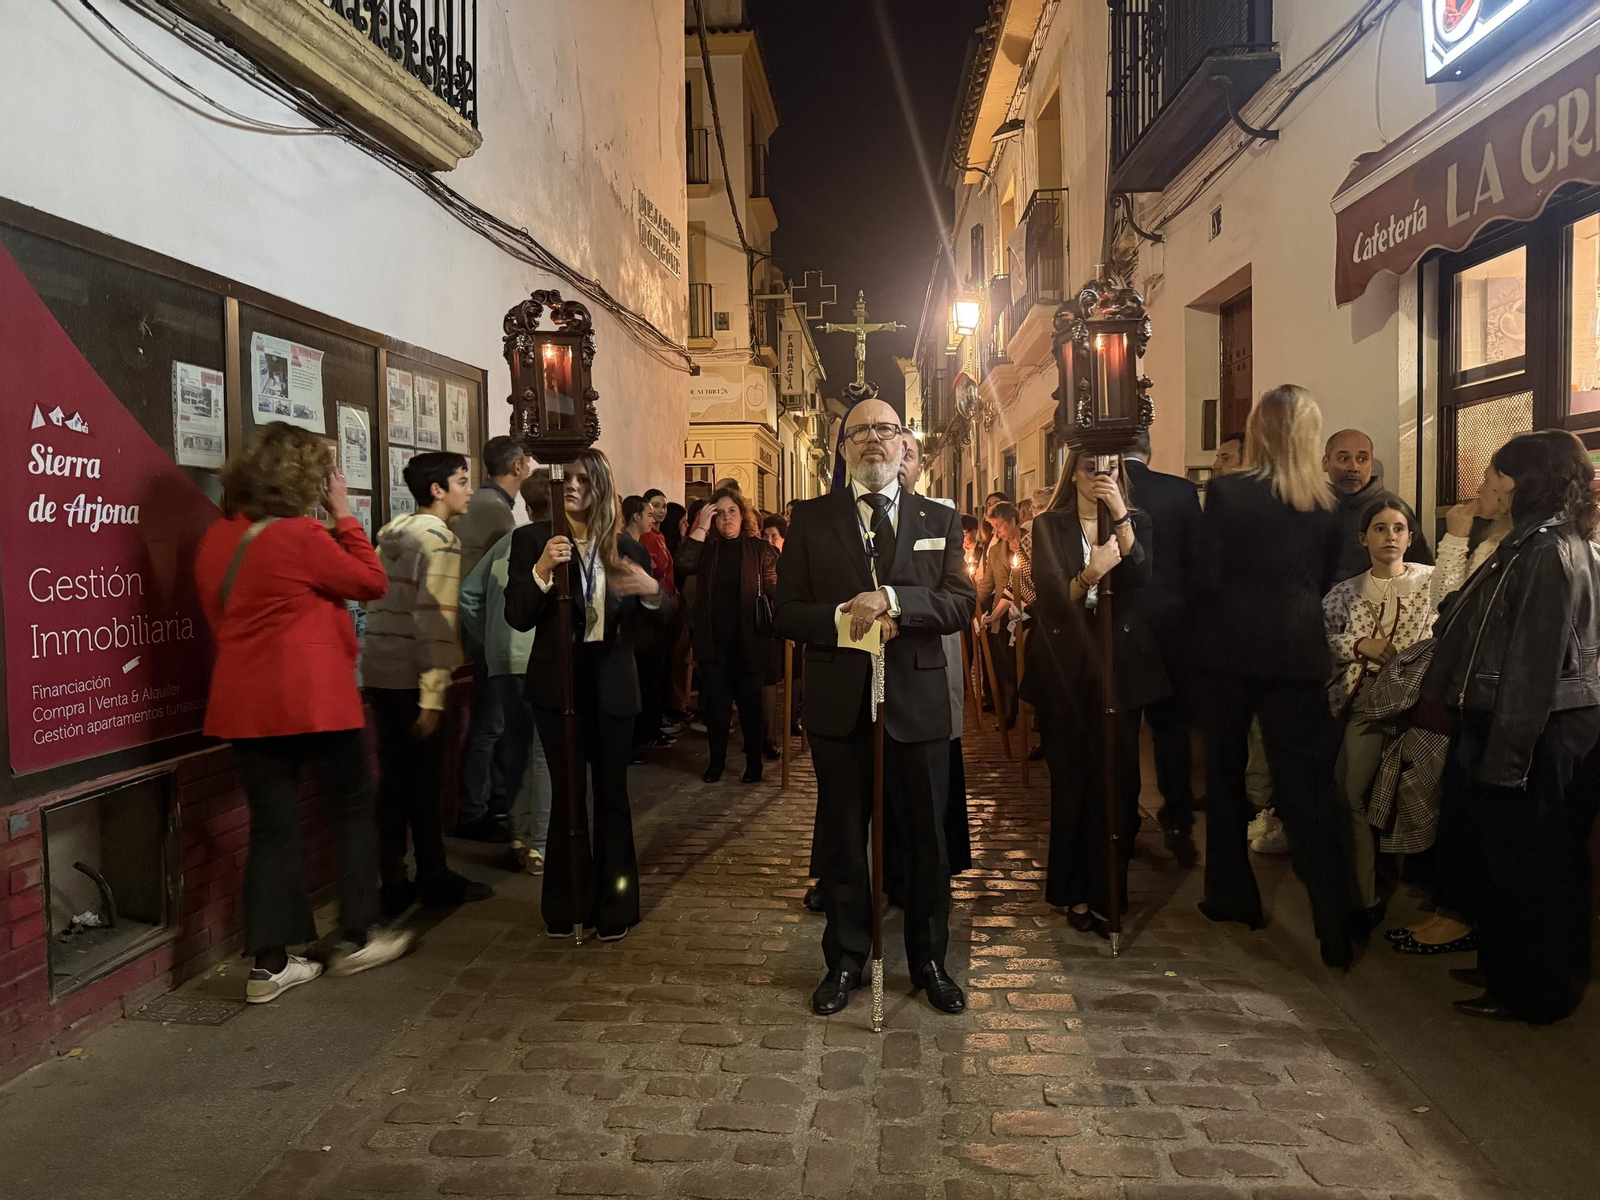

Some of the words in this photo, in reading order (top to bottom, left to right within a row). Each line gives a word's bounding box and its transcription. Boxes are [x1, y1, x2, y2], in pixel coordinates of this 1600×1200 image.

[1353, 199, 1428, 264] Cafetería
[1446, 142, 1505, 228] LA
[1520, 73, 1600, 185] CR
[786, 334, 795, 391] FARMACIA
[28, 443, 102, 479] Sierra
[28, 494, 57, 523] de
[63, 493, 140, 533] Arjona
[28, 566, 144, 603] Gestión
[31, 612, 195, 659] Inmobiliaria
[31, 675, 112, 700] Financiación
[32, 702, 86, 723] Compra
[94, 693, 129, 711] Venta
[130, 689, 140, 703] &
[141, 683, 181, 703] Alquiler
[33, 722, 84, 745] Gestión
[86, 706, 164, 735] apartamentos
[165, 697, 209, 716] turístico
